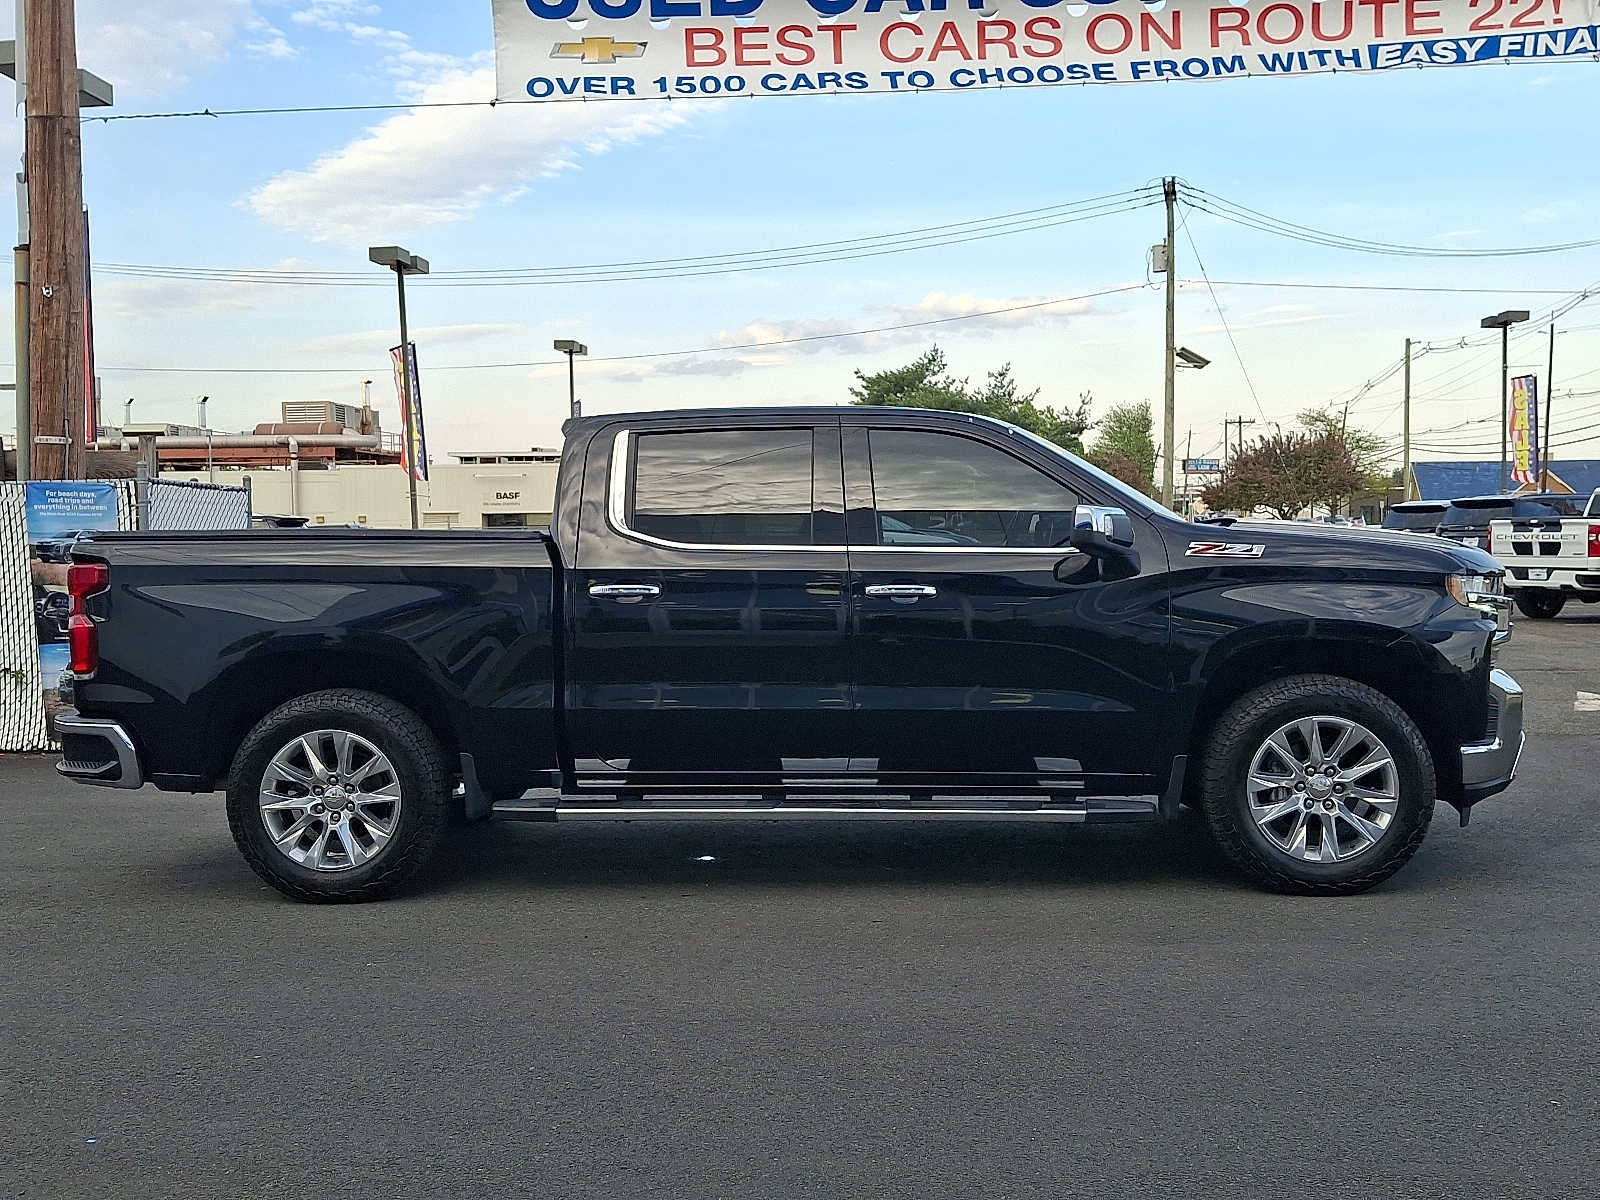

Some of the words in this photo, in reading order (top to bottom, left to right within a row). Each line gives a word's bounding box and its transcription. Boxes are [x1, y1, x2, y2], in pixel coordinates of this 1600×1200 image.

[684, 24, 857, 68] BEST
[880, 16, 1063, 64] CARS
[1085, 10, 1182, 56] ON
[1209, 0, 1443, 49] ROUTE
[1469, 0, 1563, 31] 22!
[526, 76, 636, 98] OVER
[652, 75, 746, 94] 1500
[761, 71, 869, 92] CARS
[881, 70, 936, 89] TO
[949, 62, 1115, 87] CHOOSE
[1130, 55, 1247, 80] FROM
[1258, 48, 1362, 73] WITH
[1377, 37, 1488, 70] EASY
[1498, 28, 1600, 57] FINA
[58, 490, 78, 498] beach
[496, 492, 520, 500] BASF
[64, 497, 80, 505] trips
[34, 503, 71, 511] everything
[71, 503, 78, 511] in
[1496, 533, 1579, 541] CHEVROLET
[1184, 541, 1266, 558] Z71
